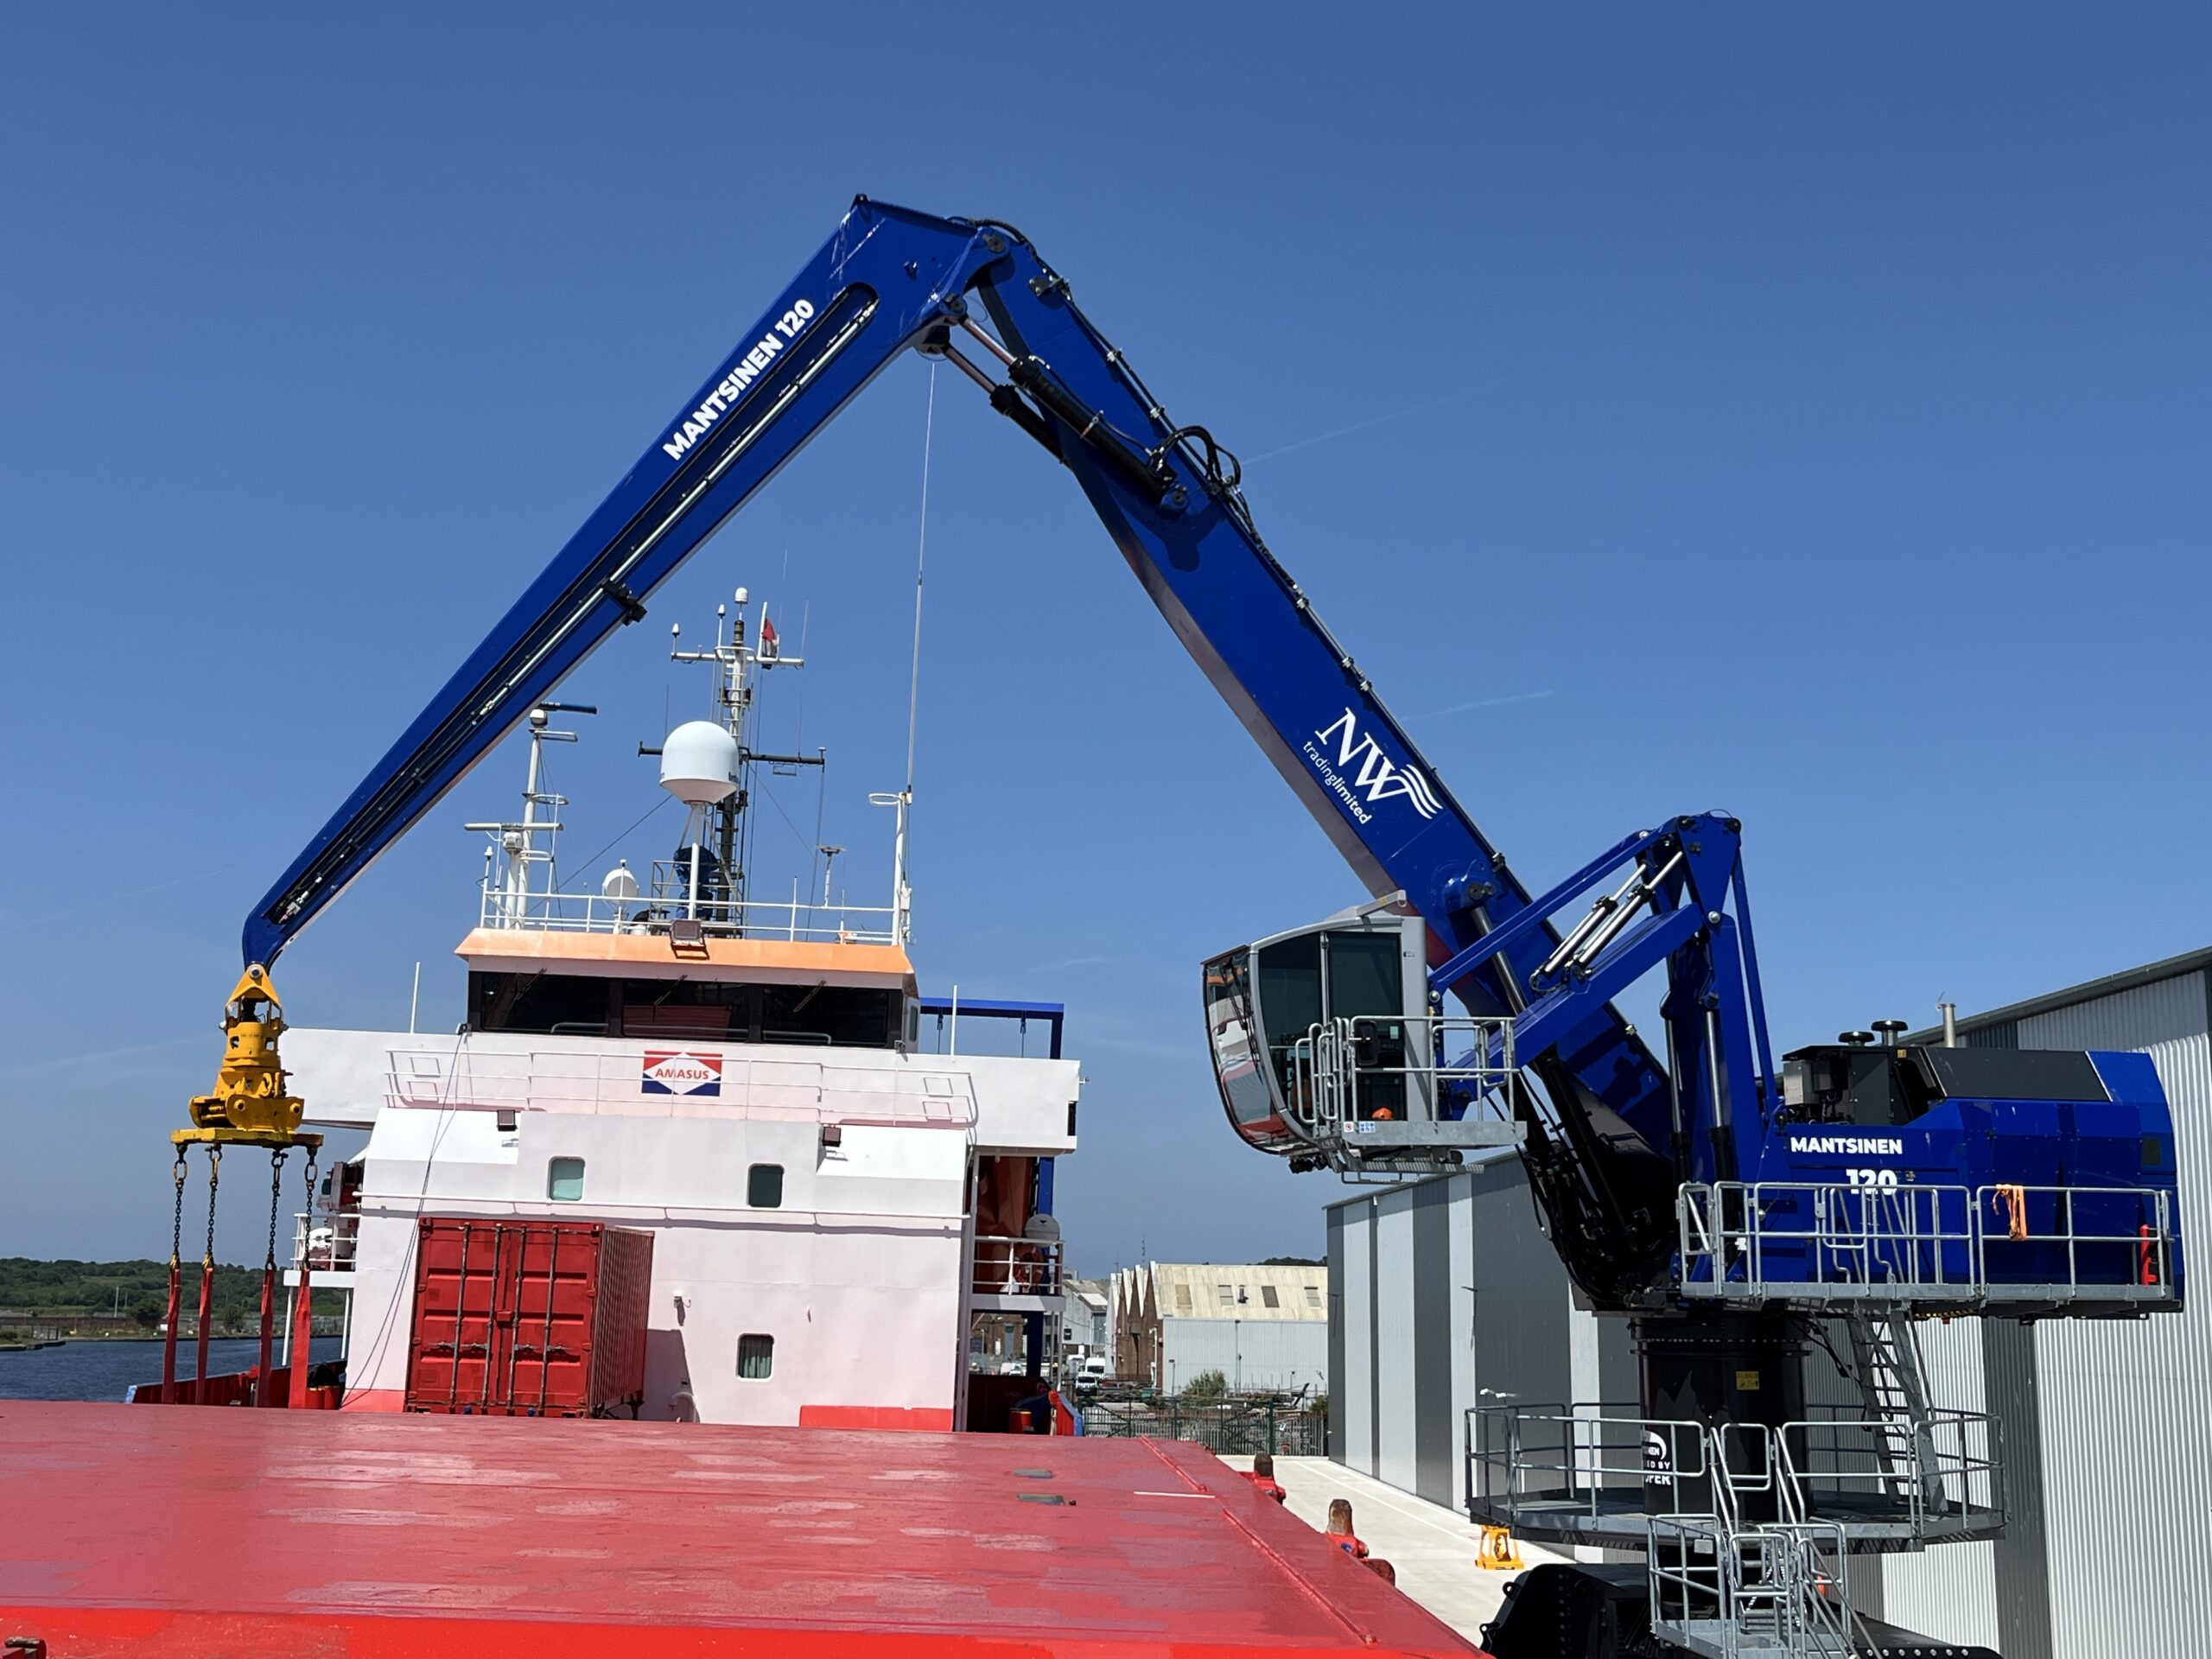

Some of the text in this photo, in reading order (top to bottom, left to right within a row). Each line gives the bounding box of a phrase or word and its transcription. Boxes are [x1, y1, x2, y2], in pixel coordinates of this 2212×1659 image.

[662, 299, 814, 461] MANTSINEN 120
[1314, 707, 1421, 808] NW
[655, 1068, 709, 1080] AMASUS
[1790, 1137, 1903, 1154] MANTSINEN
[1846, 1168, 1897, 1195] 120
[1658, 1461, 1670, 1470] BY
